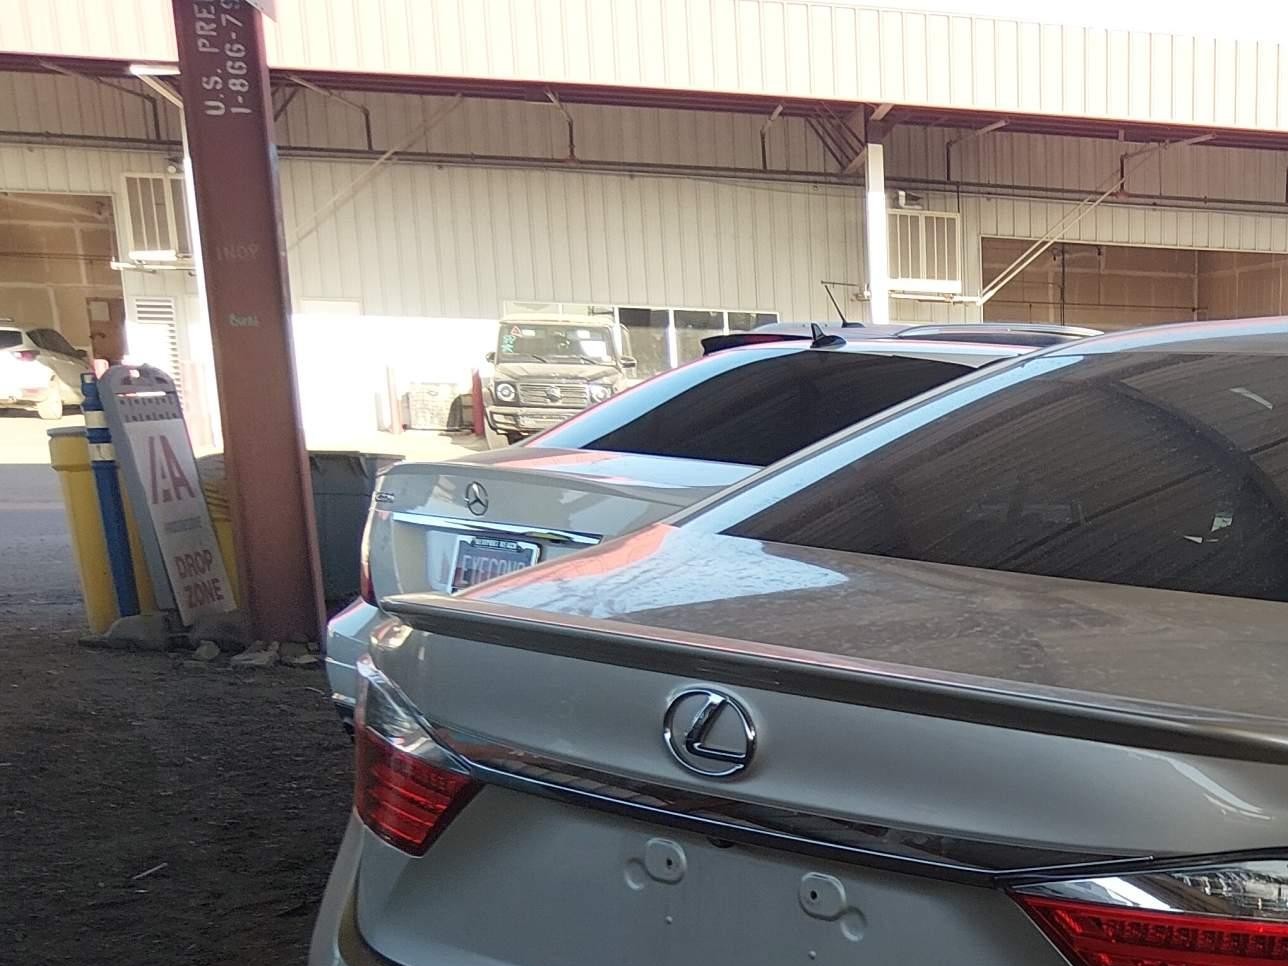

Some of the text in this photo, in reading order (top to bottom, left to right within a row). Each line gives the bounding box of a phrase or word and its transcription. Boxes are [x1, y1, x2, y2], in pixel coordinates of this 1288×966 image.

[193, 0, 225, 115] U.S. PRE
[174, 549, 213, 577] DROP
[183, 577, 224, 608] ZONE
